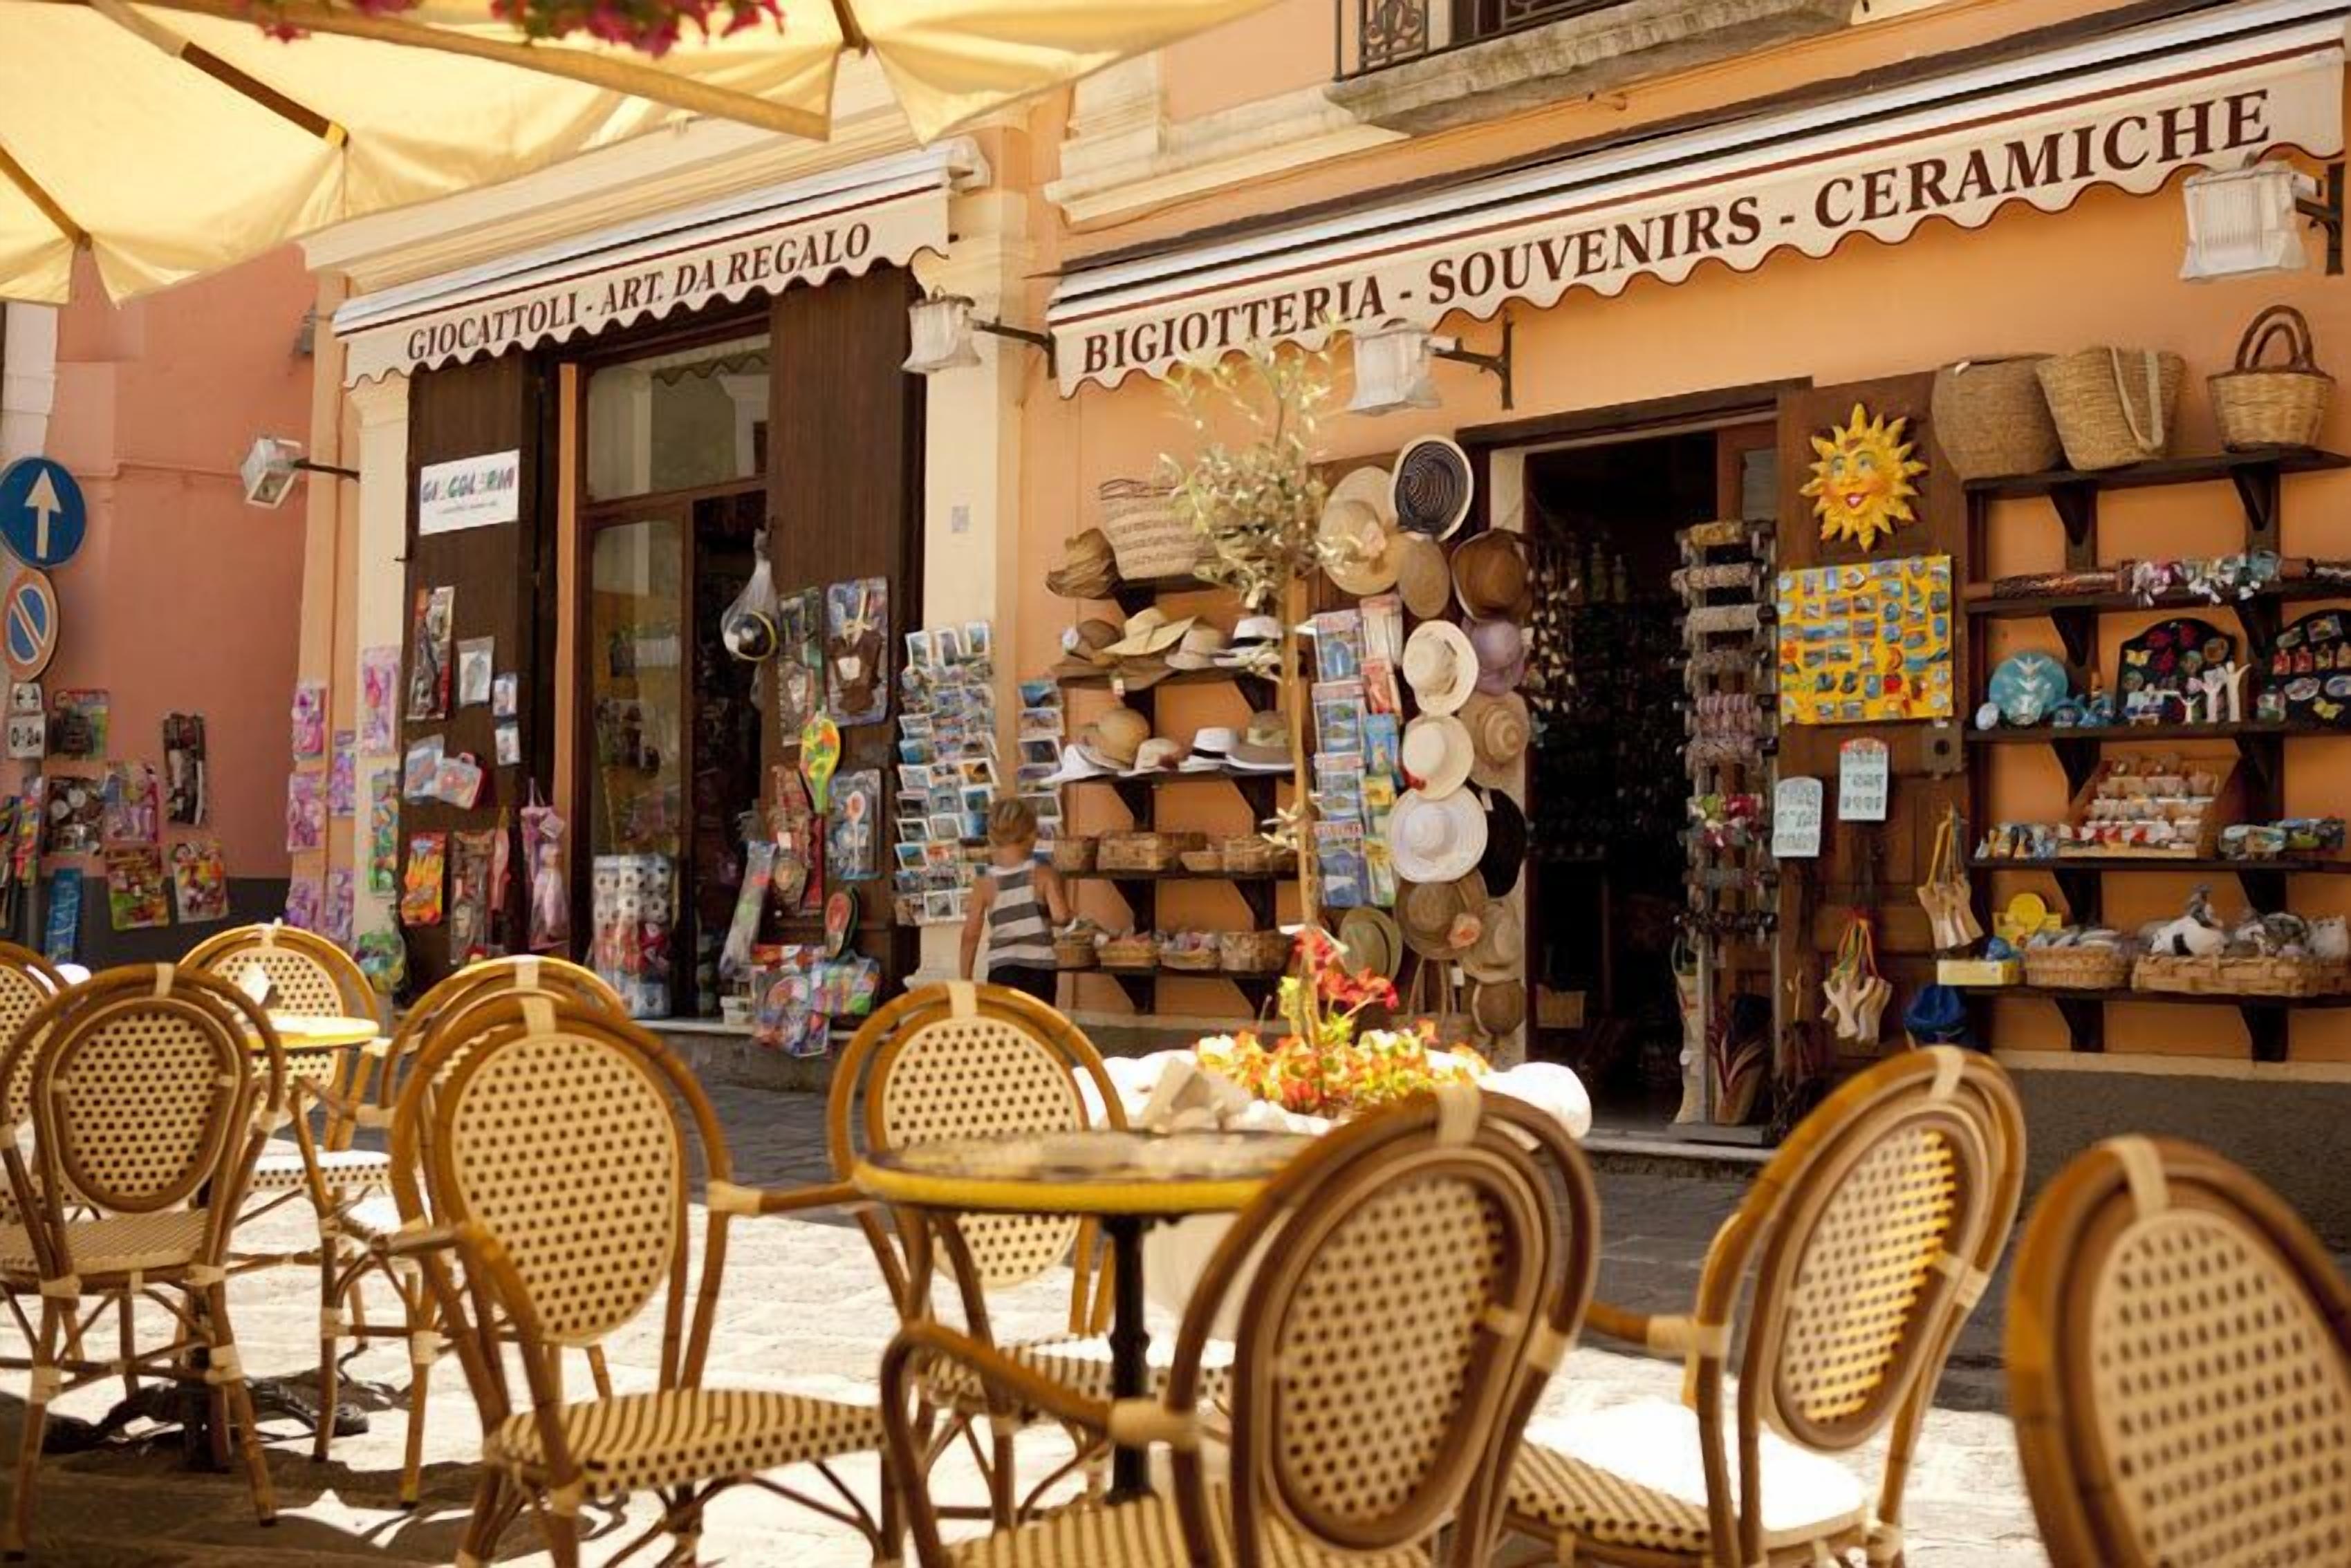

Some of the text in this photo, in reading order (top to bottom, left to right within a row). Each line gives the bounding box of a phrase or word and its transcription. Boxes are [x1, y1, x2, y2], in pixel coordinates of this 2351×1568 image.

[407, 222, 871, 360] GIOCATTOLI - ART. DA REGALO
[1084, 89, 2271, 374] BIGIOTTERIA - SOUVENIRS - CERAMICHE
